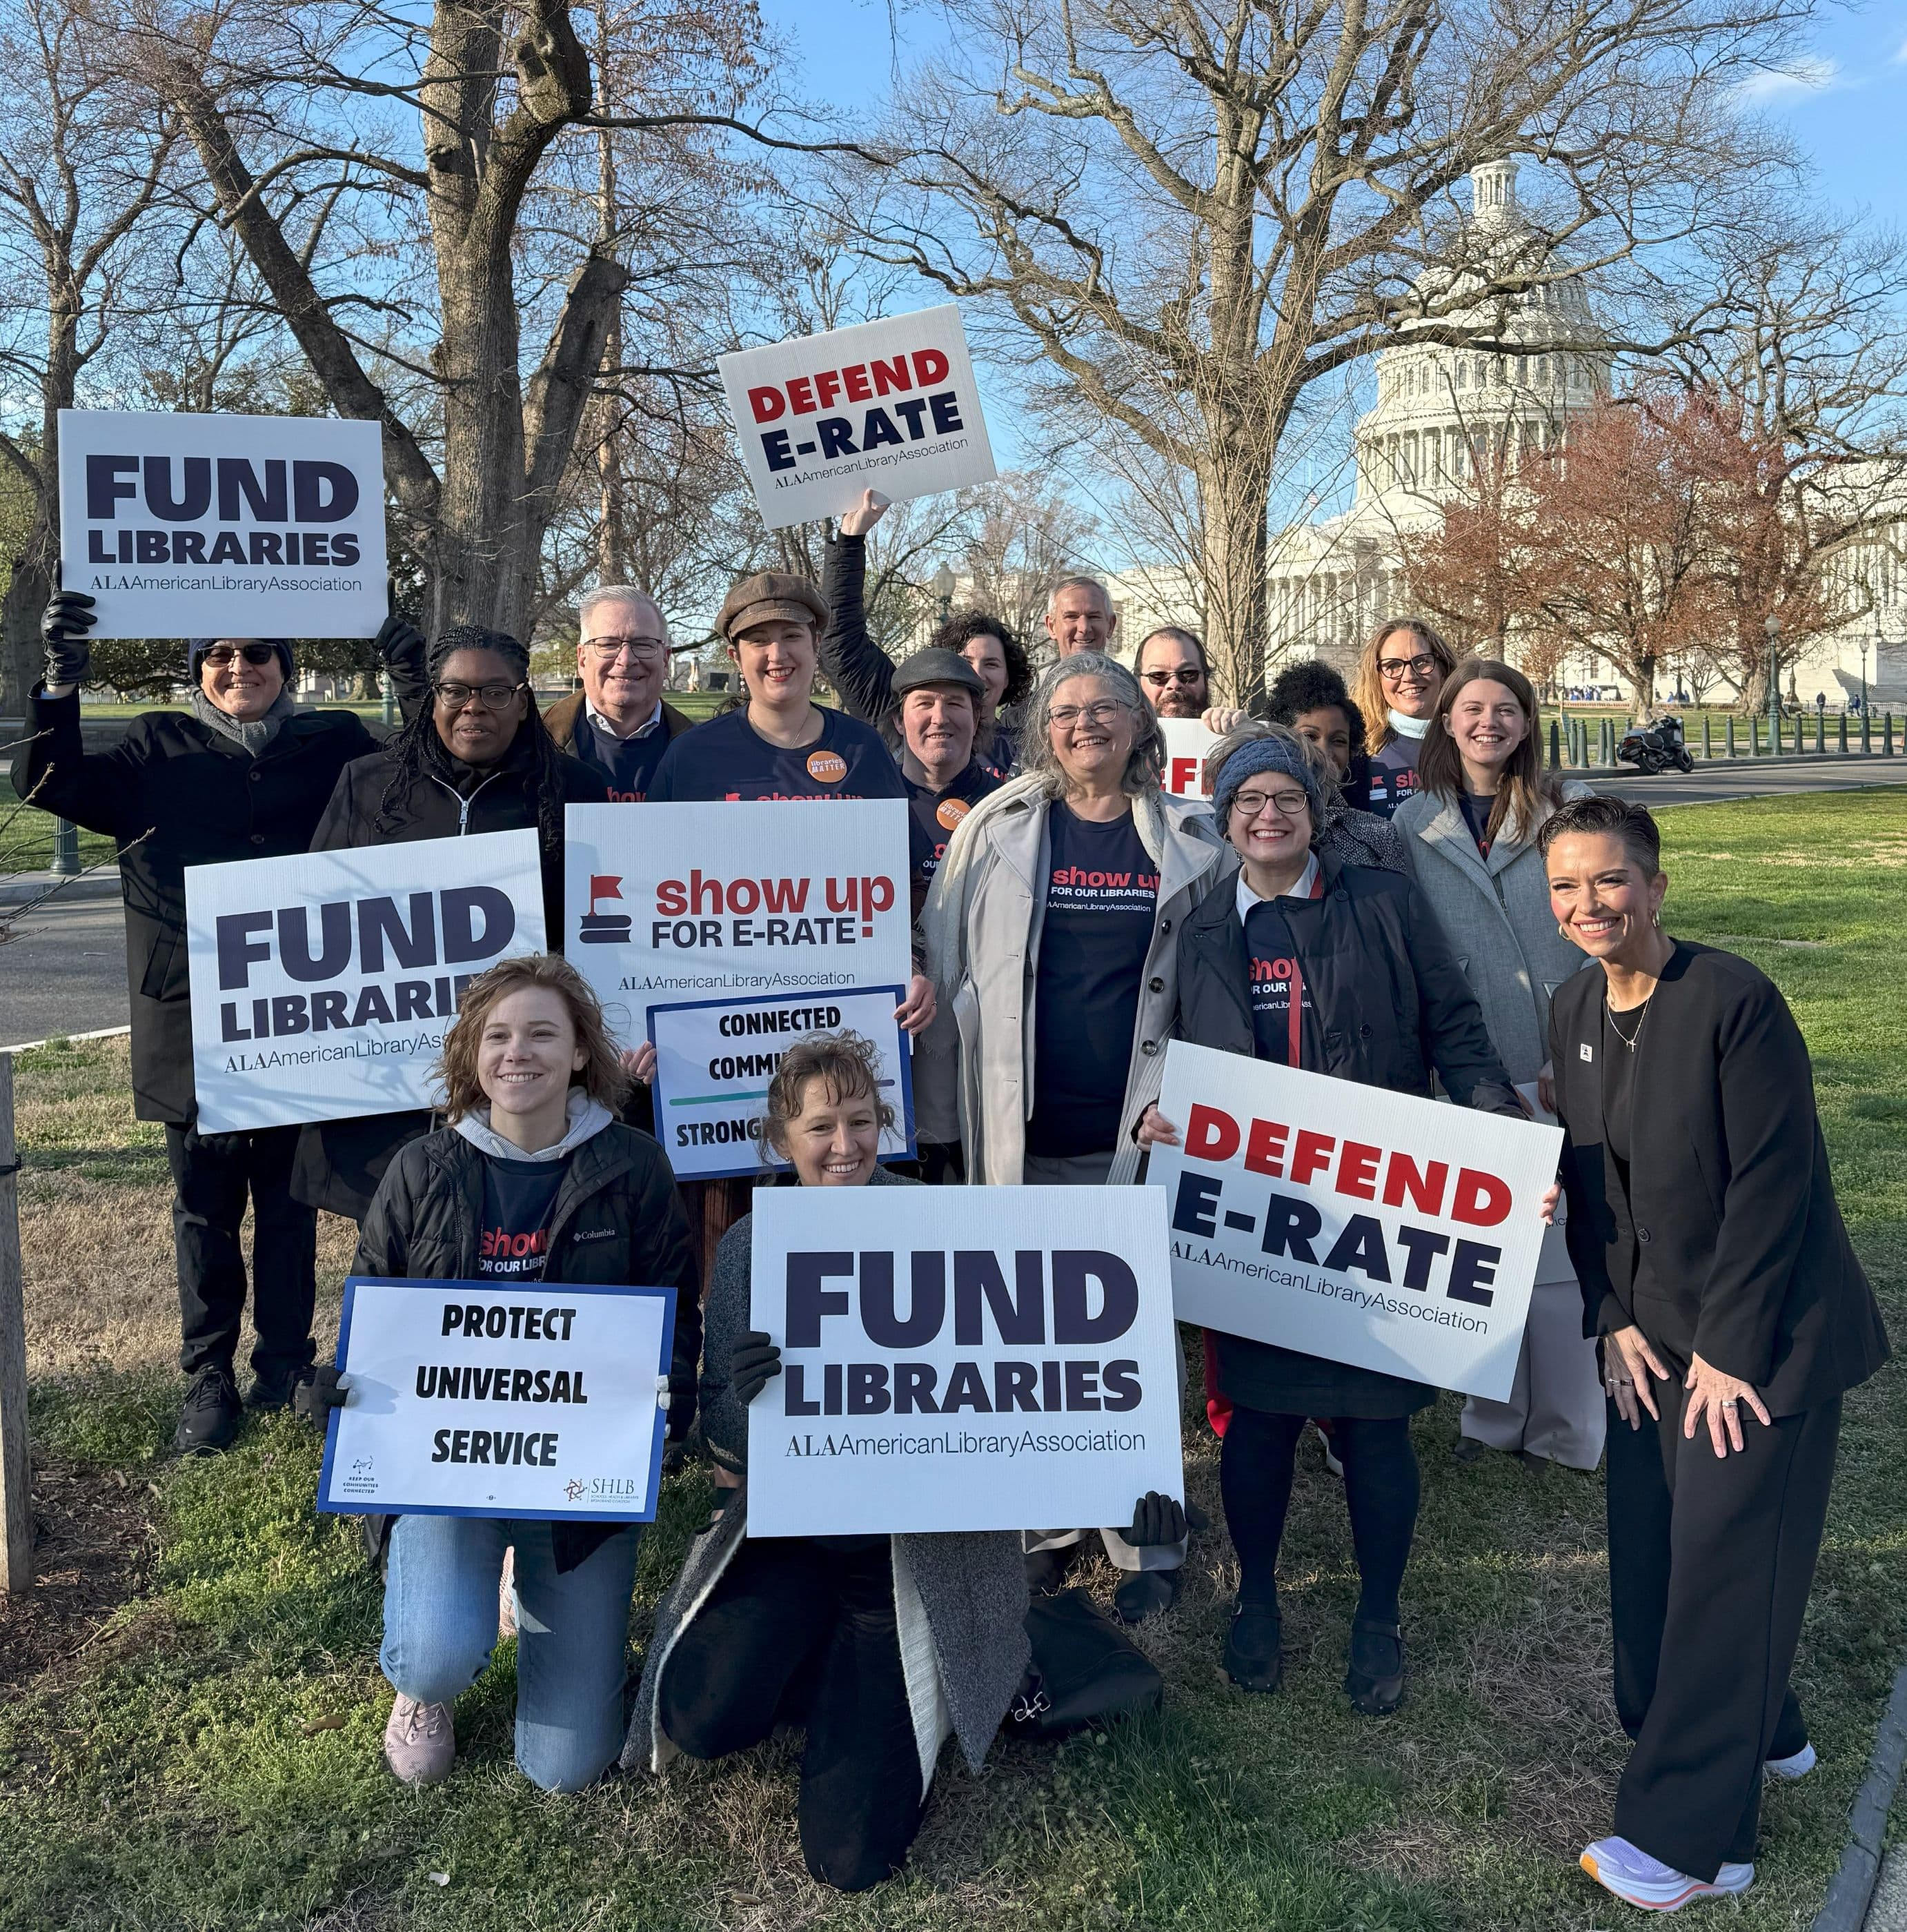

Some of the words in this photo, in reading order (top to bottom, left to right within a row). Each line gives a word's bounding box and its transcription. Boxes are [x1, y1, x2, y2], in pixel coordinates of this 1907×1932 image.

[749, 349, 949, 423] DEFEND
[760, 391, 964, 472] E-RATE
[86, 455, 359, 522] FUND
[88, 530, 360, 566] LIBRARIES
[812, 763, 844, 773] MATTER
[1396, 789, 1412, 797] FOR
[939, 807, 962, 822] MATT
[656, 869, 810, 916] show
[1051, 887, 1072, 896] FOR
[1075, 887, 1098, 897] OUR
[1100, 889, 1155, 898] LIBRARIES
[1052, 866, 1132, 887] show
[217, 886, 515, 991] FUND
[653, 920, 722, 948] FOR
[1263, 982, 1287, 994] OUR
[221, 973, 483, 1043] LIBRARI
[719, 1006, 841, 1037] CONNECTED
[224, 1032, 448, 1074] ALAAmericanLibraryAs
[677, 1114, 763, 1147] STRONG
[1185, 1104, 1512, 1227] DEFEND
[582, 1229, 615, 1240] Columbia
[1172, 1171, 1502, 1308] E-RATE
[480, 1259, 493, 1272] OR
[494, 1261, 520, 1272] OUR
[785, 1250, 1139, 1348] FUND
[441, 1304, 577, 1341] PROTECT
[416, 1366, 588, 1404] UNIVERSAL
[785, 1359, 1143, 1416] LIBRARIES
[431, 1429, 559, 1466] SERVICE
[591, 1478, 634, 1494] SHLB
